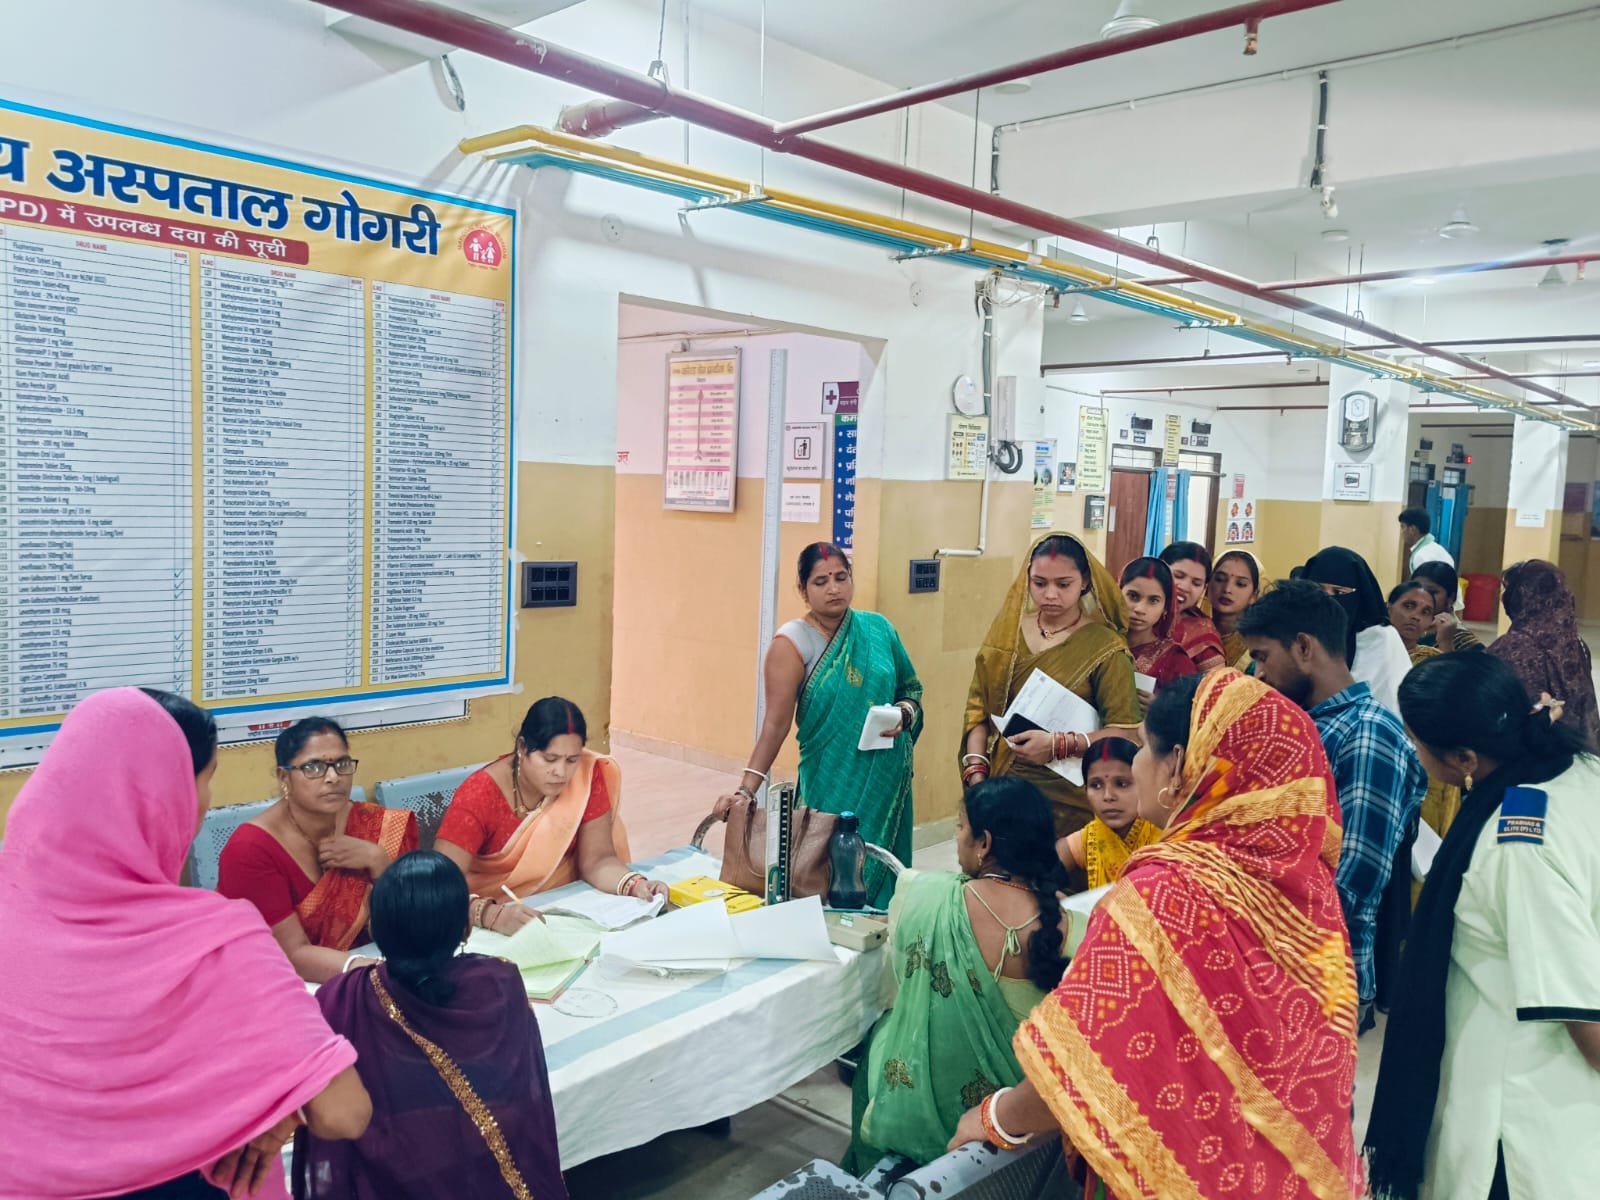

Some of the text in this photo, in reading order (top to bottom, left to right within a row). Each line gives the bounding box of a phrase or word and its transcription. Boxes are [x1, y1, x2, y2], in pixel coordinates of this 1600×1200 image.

[46, 150, 293, 230] अस्पताल
[302, 190, 441, 255] गोगरी
[57, 204, 287, 259] में उपलब्ध दवा की सूची
